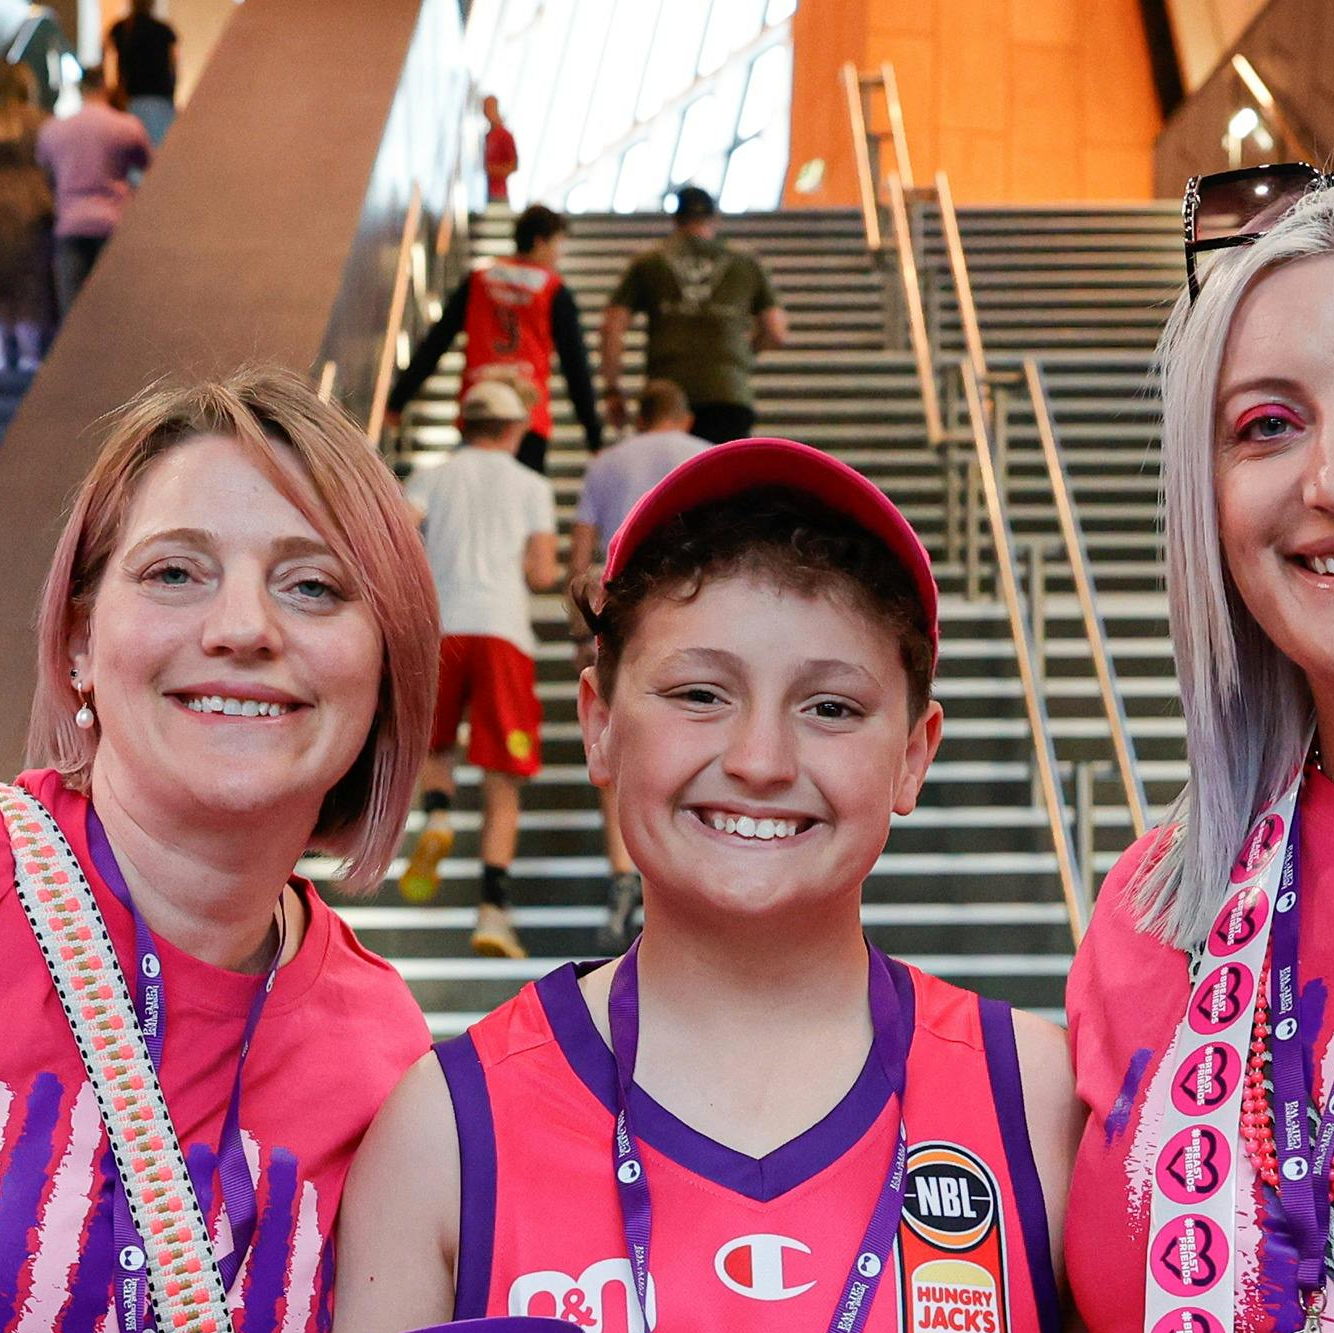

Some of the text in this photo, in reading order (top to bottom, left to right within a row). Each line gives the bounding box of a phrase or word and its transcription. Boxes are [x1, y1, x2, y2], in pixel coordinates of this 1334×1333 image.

[142, 985, 153, 1036] care wa
[1197, 1062, 1206, 1107] FRIENDS
[1204, 1045, 1215, 1095] #BREAST
[1289, 1100, 1301, 1149] care wa
[1184, 1146, 1197, 1193] FRIENDS
[1190, 1128, 1204, 1181] #BREAST
[915, 1176, 978, 1218] NBL
[1178, 1236, 1193, 1286] FRIENDS
[1183, 1217, 1200, 1274] #BREAST
[123, 1278, 133, 1331] care wa
[837, 1281, 863, 1333] care wa
[917, 1286, 993, 1308] HUNGRY
[918, 1306, 997, 1333] JACK'S
